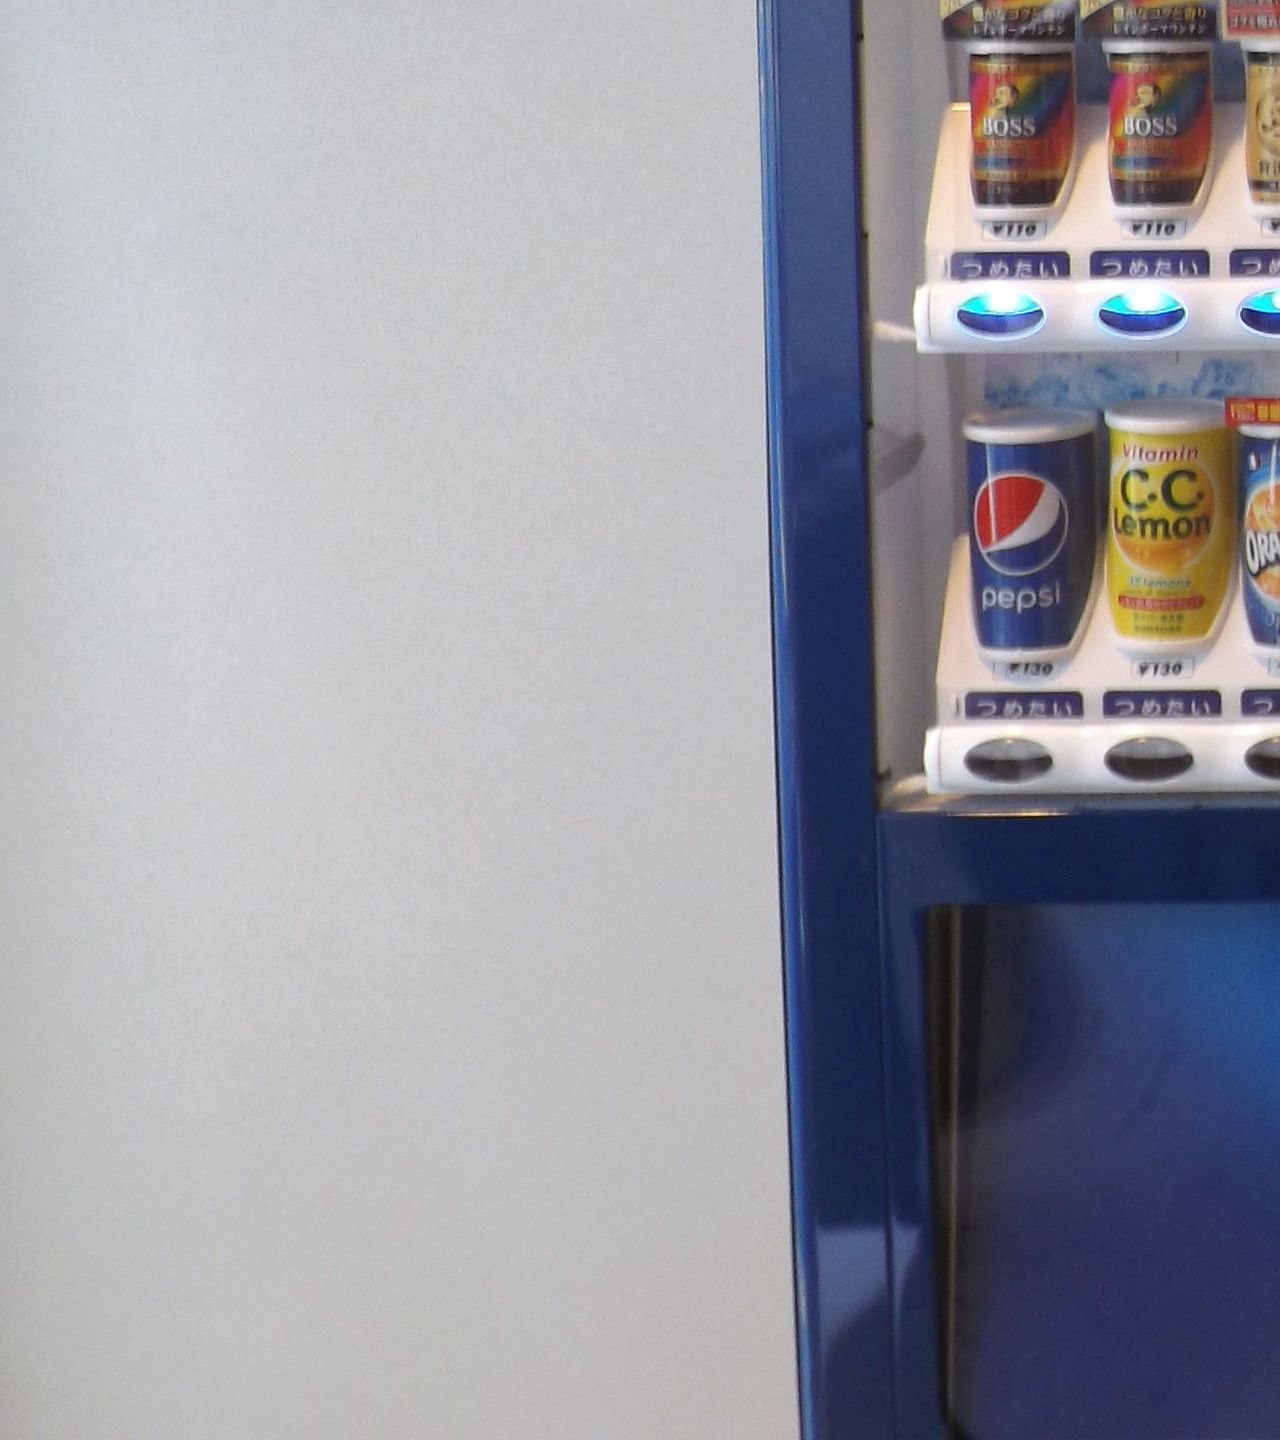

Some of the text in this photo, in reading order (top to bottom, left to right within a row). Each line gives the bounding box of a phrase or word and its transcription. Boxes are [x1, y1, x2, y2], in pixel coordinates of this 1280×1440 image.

[982, 117, 1037, 137] BOSS
[1123, 117, 1178, 137] BOSS
[962, 257, 1059, 277] つめたい
[1101, 257, 1199, 277] つめたい
[1122, 445, 1199, 463] Vitamin
[1113, 506, 1211, 541] Lemon
[981, 582, 1061, 615] pepsi
[974, 698, 1073, 716] つめたい
[1114, 697, 1211, 715] つめたい
